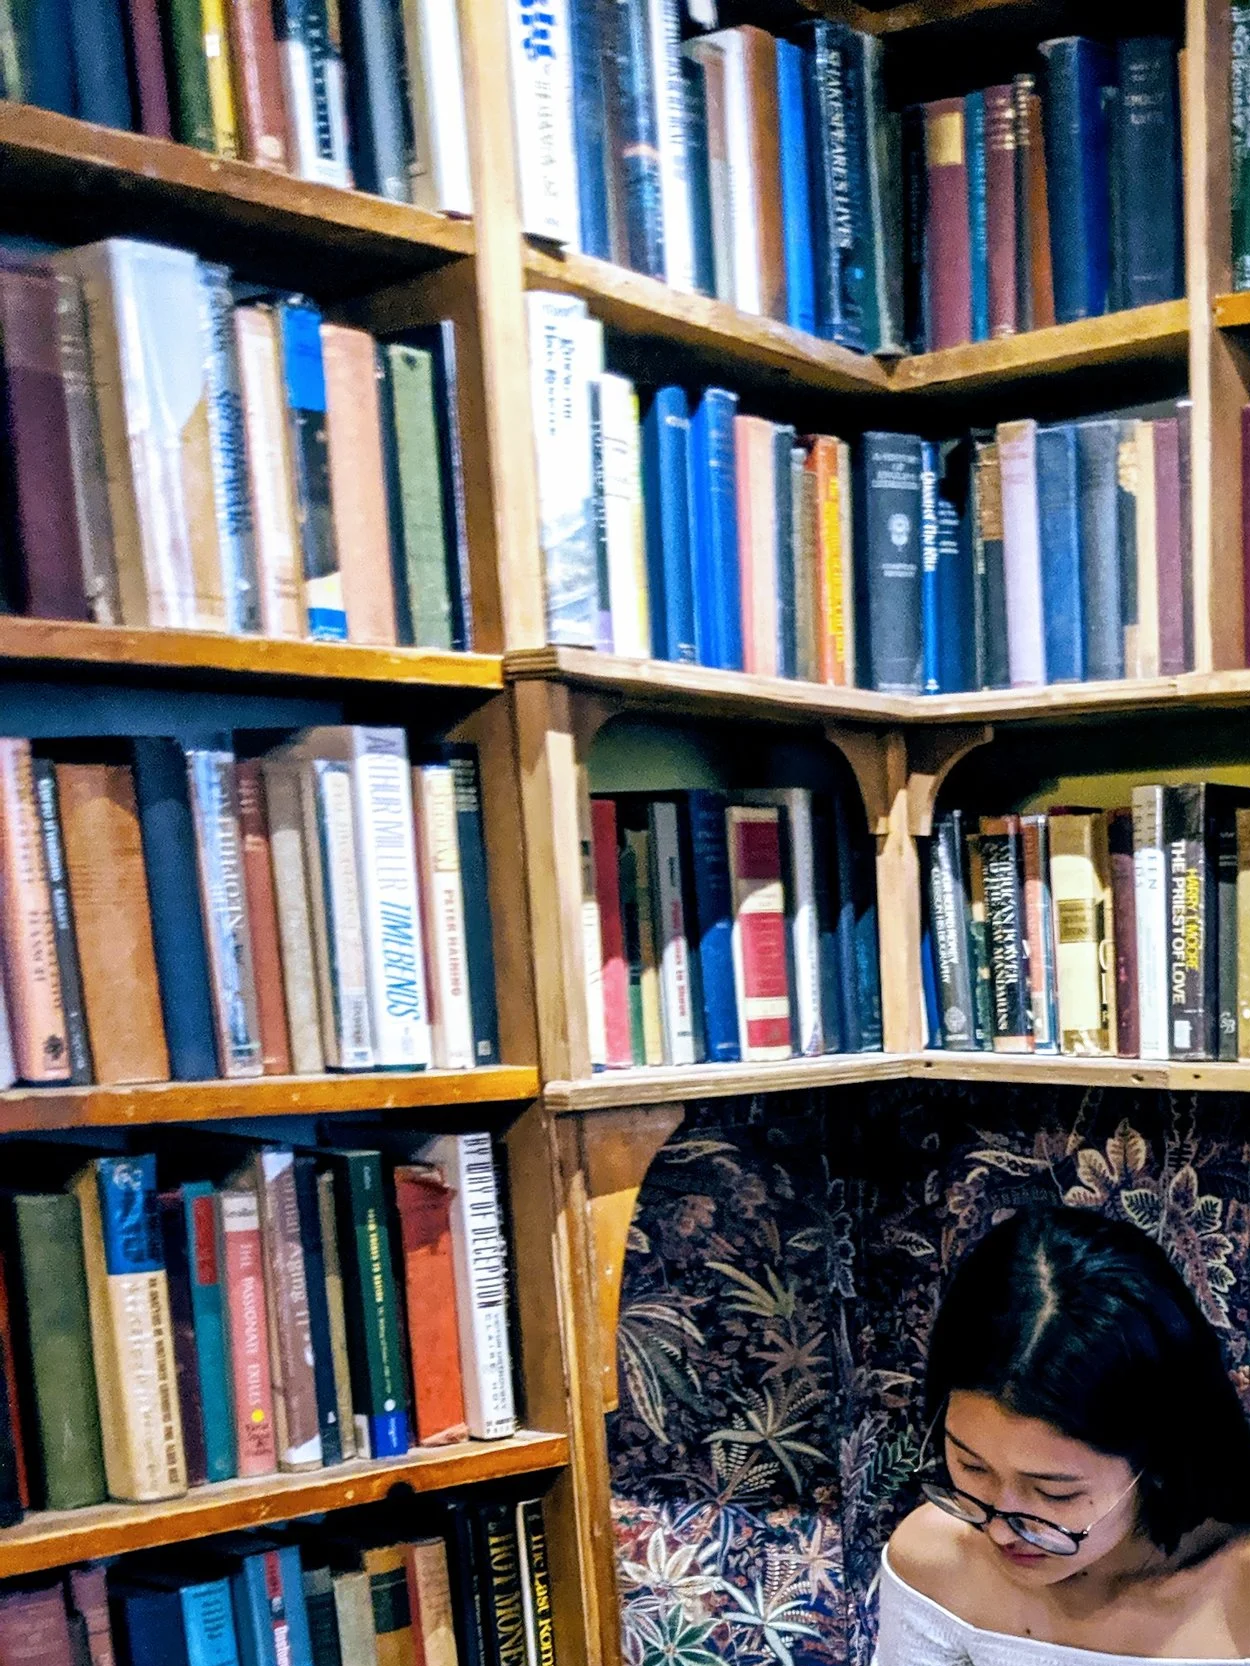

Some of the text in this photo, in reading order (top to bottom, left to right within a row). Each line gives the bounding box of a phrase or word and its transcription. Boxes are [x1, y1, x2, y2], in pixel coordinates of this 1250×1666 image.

[365, 735, 419, 1021] ARTHUR MILLER TIMEBENDS
[1183, 867, 1198, 913] HARRY
[442, 888, 456, 932] PETER
[1170, 840, 1186, 1005] THE PRIEST OF LOVE
[445, 935, 462, 997] HAINING
[1184, 923, 1199, 972] MOORE
[462, 1137, 505, 1310] BY WAY OF DECEPTION
[238, 1243, 254, 1269] THE
[285, 1241, 308, 1304] Aging
[240, 1275, 258, 1356] PASSIONATE
[484, 1313, 498, 1411] CLAIRE HOY
[486, 1532, 519, 1588] HOT
[529, 1530, 547, 1569] The
[532, 1571, 553, 1615] Last
